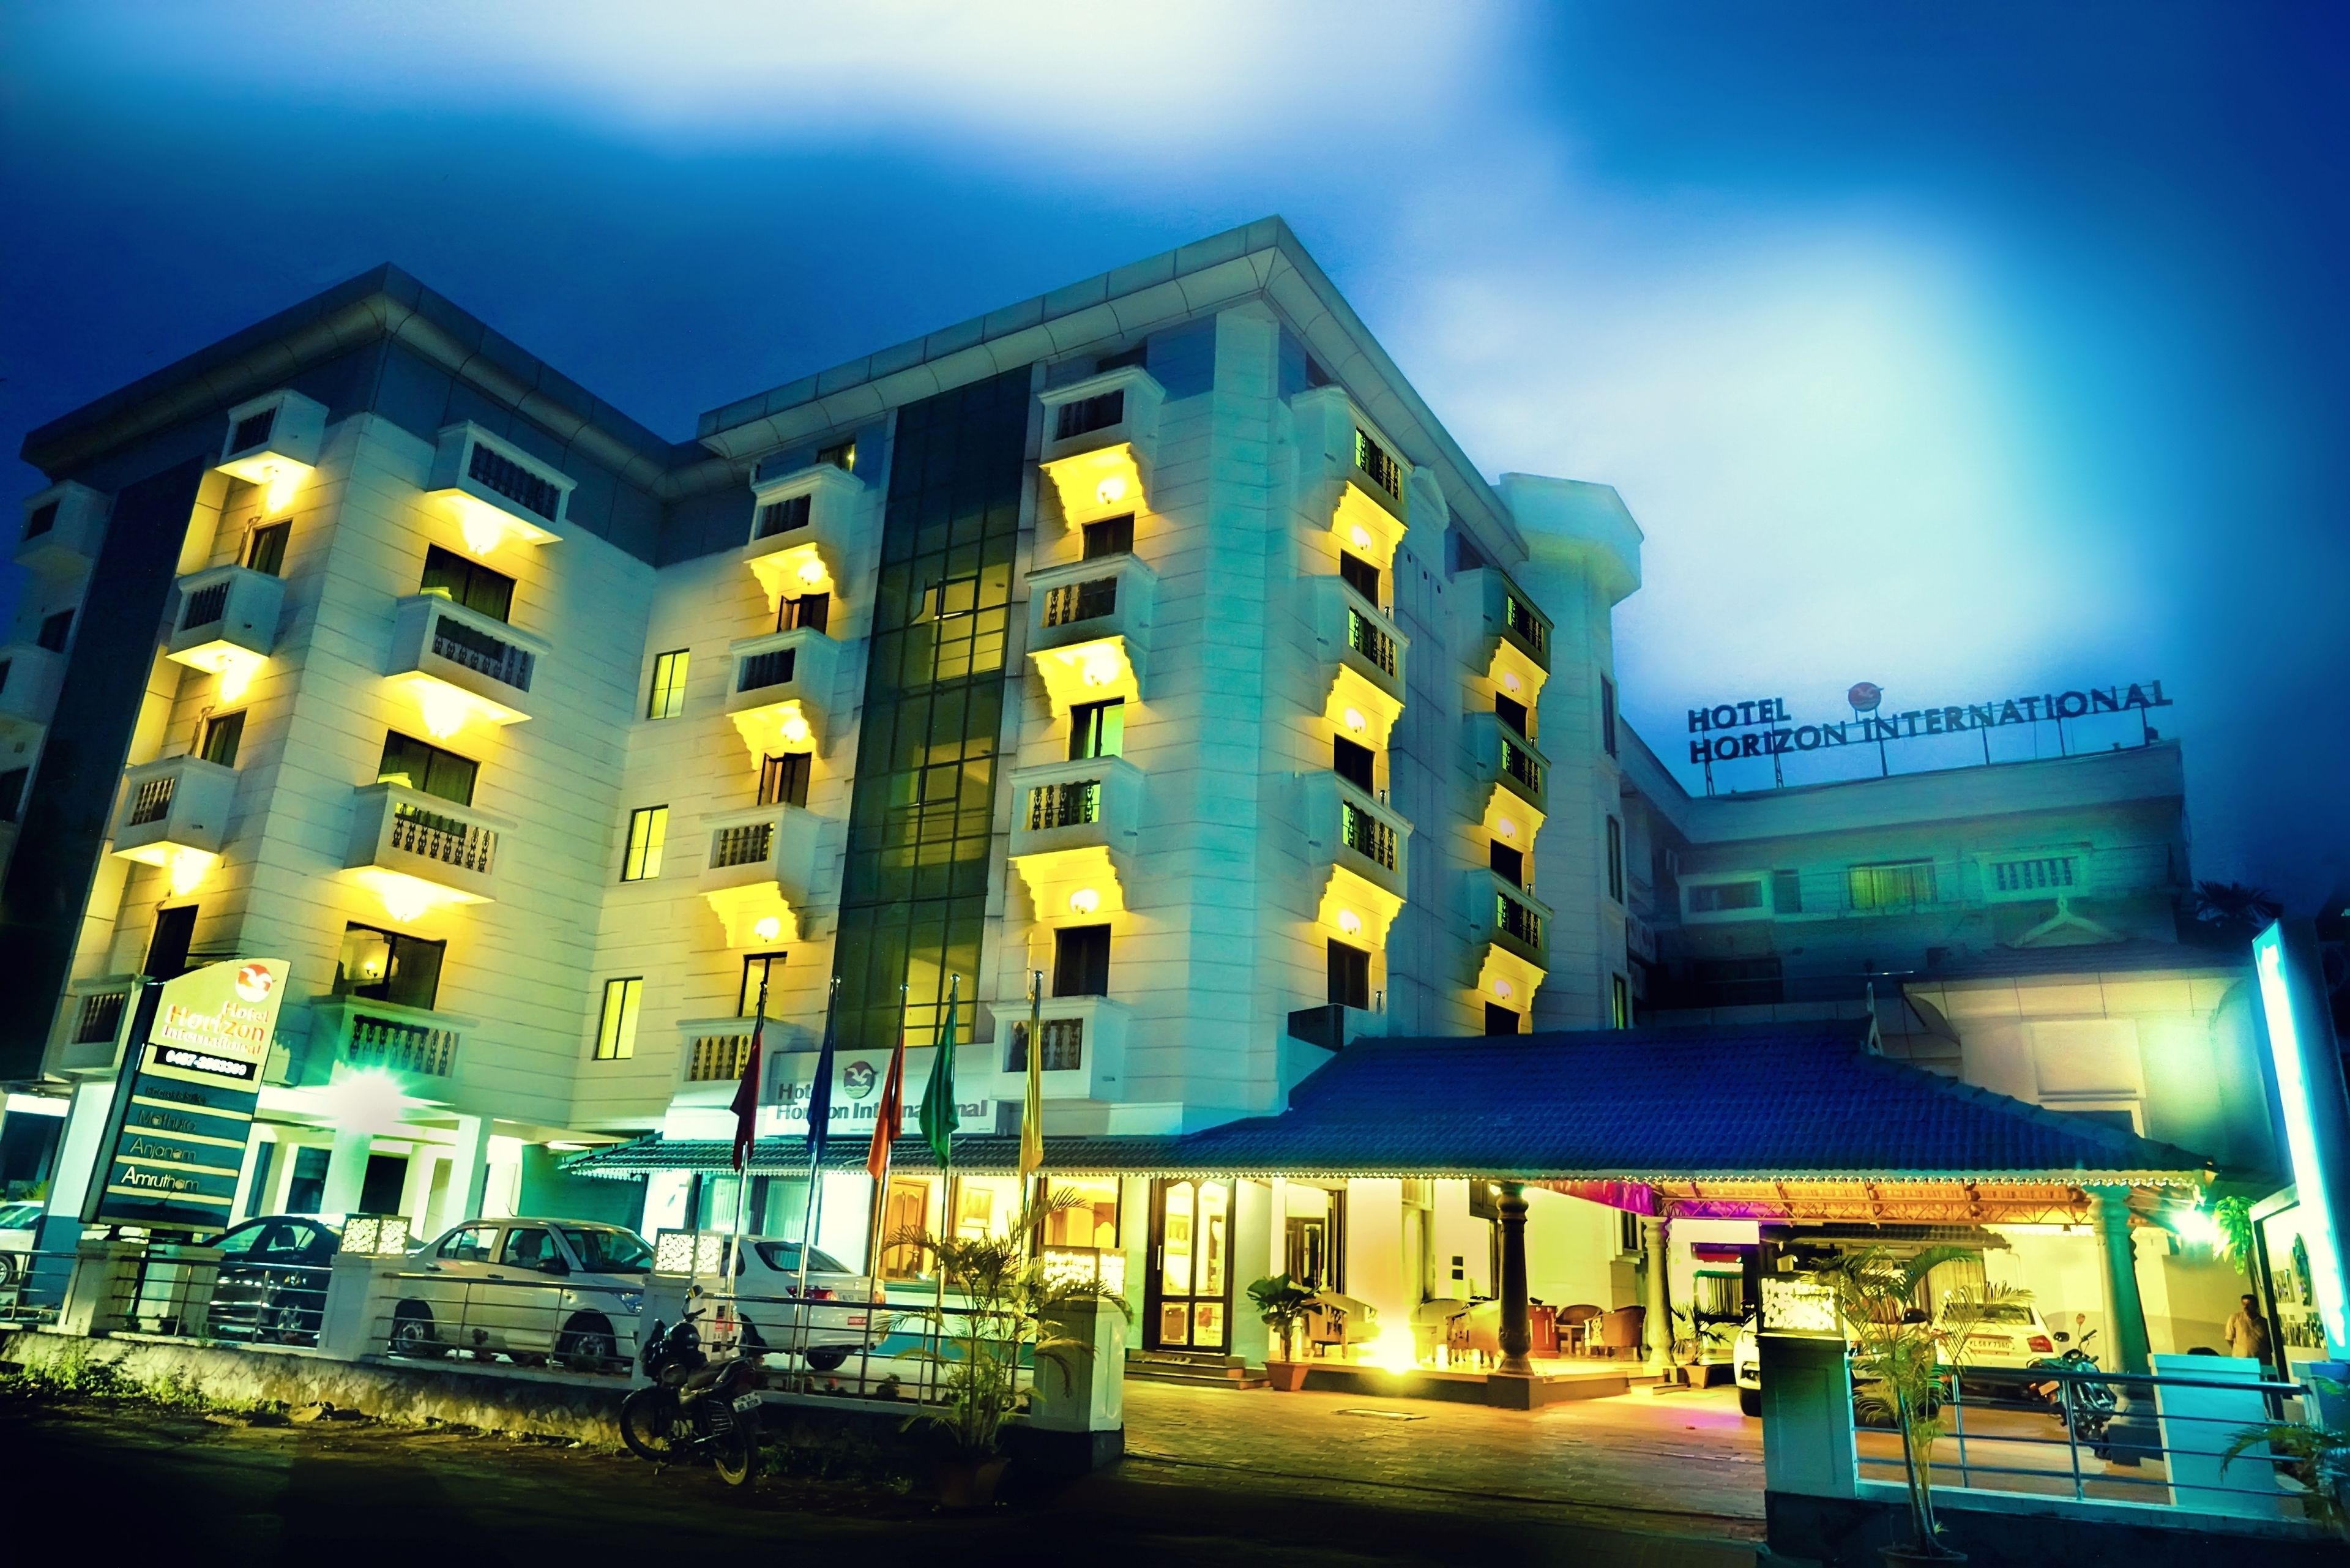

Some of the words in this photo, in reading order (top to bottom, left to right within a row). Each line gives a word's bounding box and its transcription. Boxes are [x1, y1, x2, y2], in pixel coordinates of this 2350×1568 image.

[1688, 697, 1792, 733] HOTEL
[1690, 720, 1848, 764] HORIZON
[1863, 679, 2174, 742] INTERNATIONAL
[165, 1004, 264, 1042] Horizon
[223, 1001, 269, 1023] Hotel
[162, 1024, 261, 1055] International
[778, 1083, 811, 1100] Hot
[777, 1103, 849, 1119] Horon
[852, 1099, 988, 1119] Intnanal
[130, 1137, 196, 1162] Anjanam
[121, 1165, 199, 1192] Amrutham
